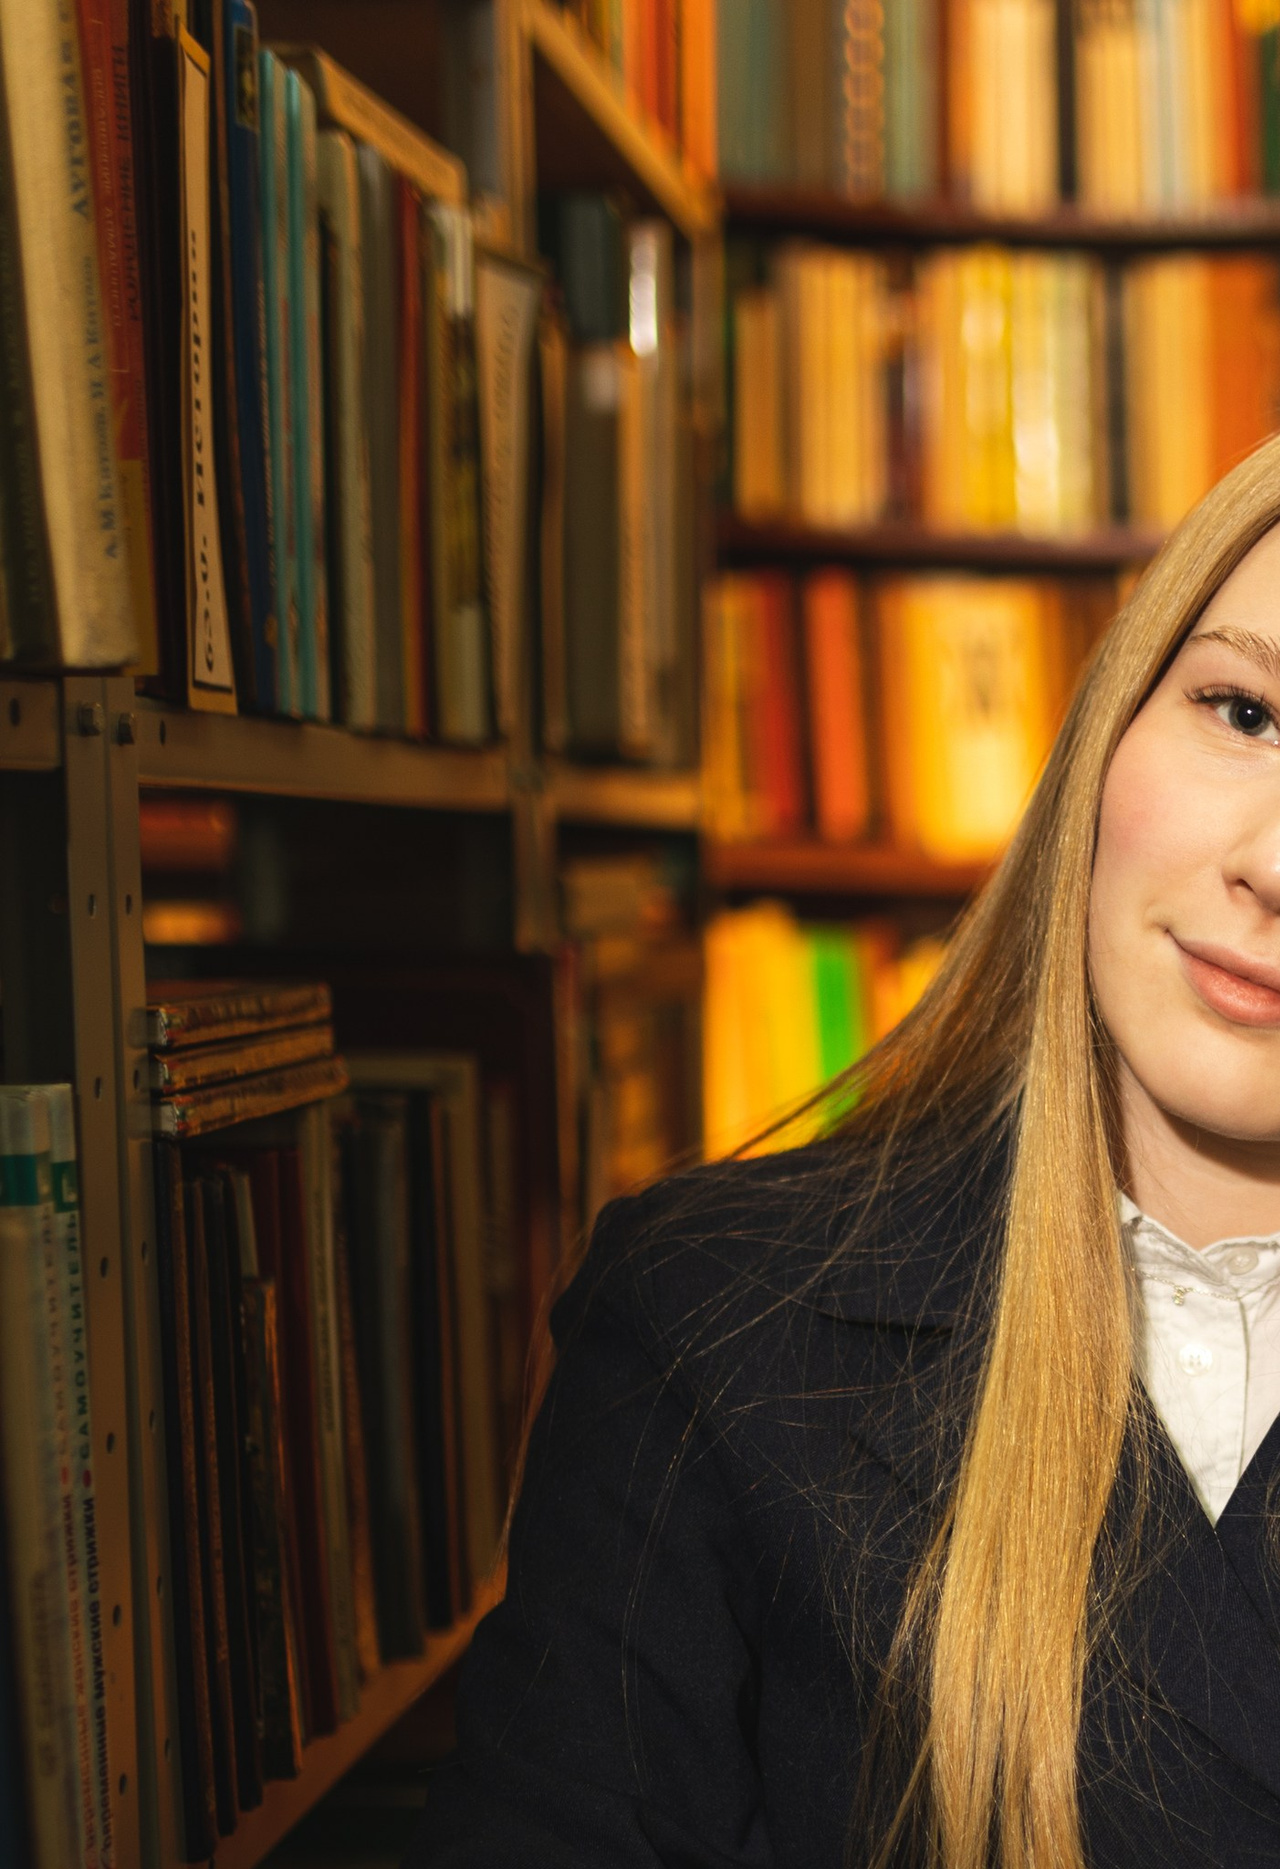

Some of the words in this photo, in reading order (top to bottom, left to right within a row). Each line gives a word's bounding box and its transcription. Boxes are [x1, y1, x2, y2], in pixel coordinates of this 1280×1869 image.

[65, 1212, 90, 1461] САМОУЧИТЕЛЬ
[62, 1494, 79, 1592] стрижки
[82, 1497, 99, 1595] стрижки
[87, 1600, 106, 1699] мужские
